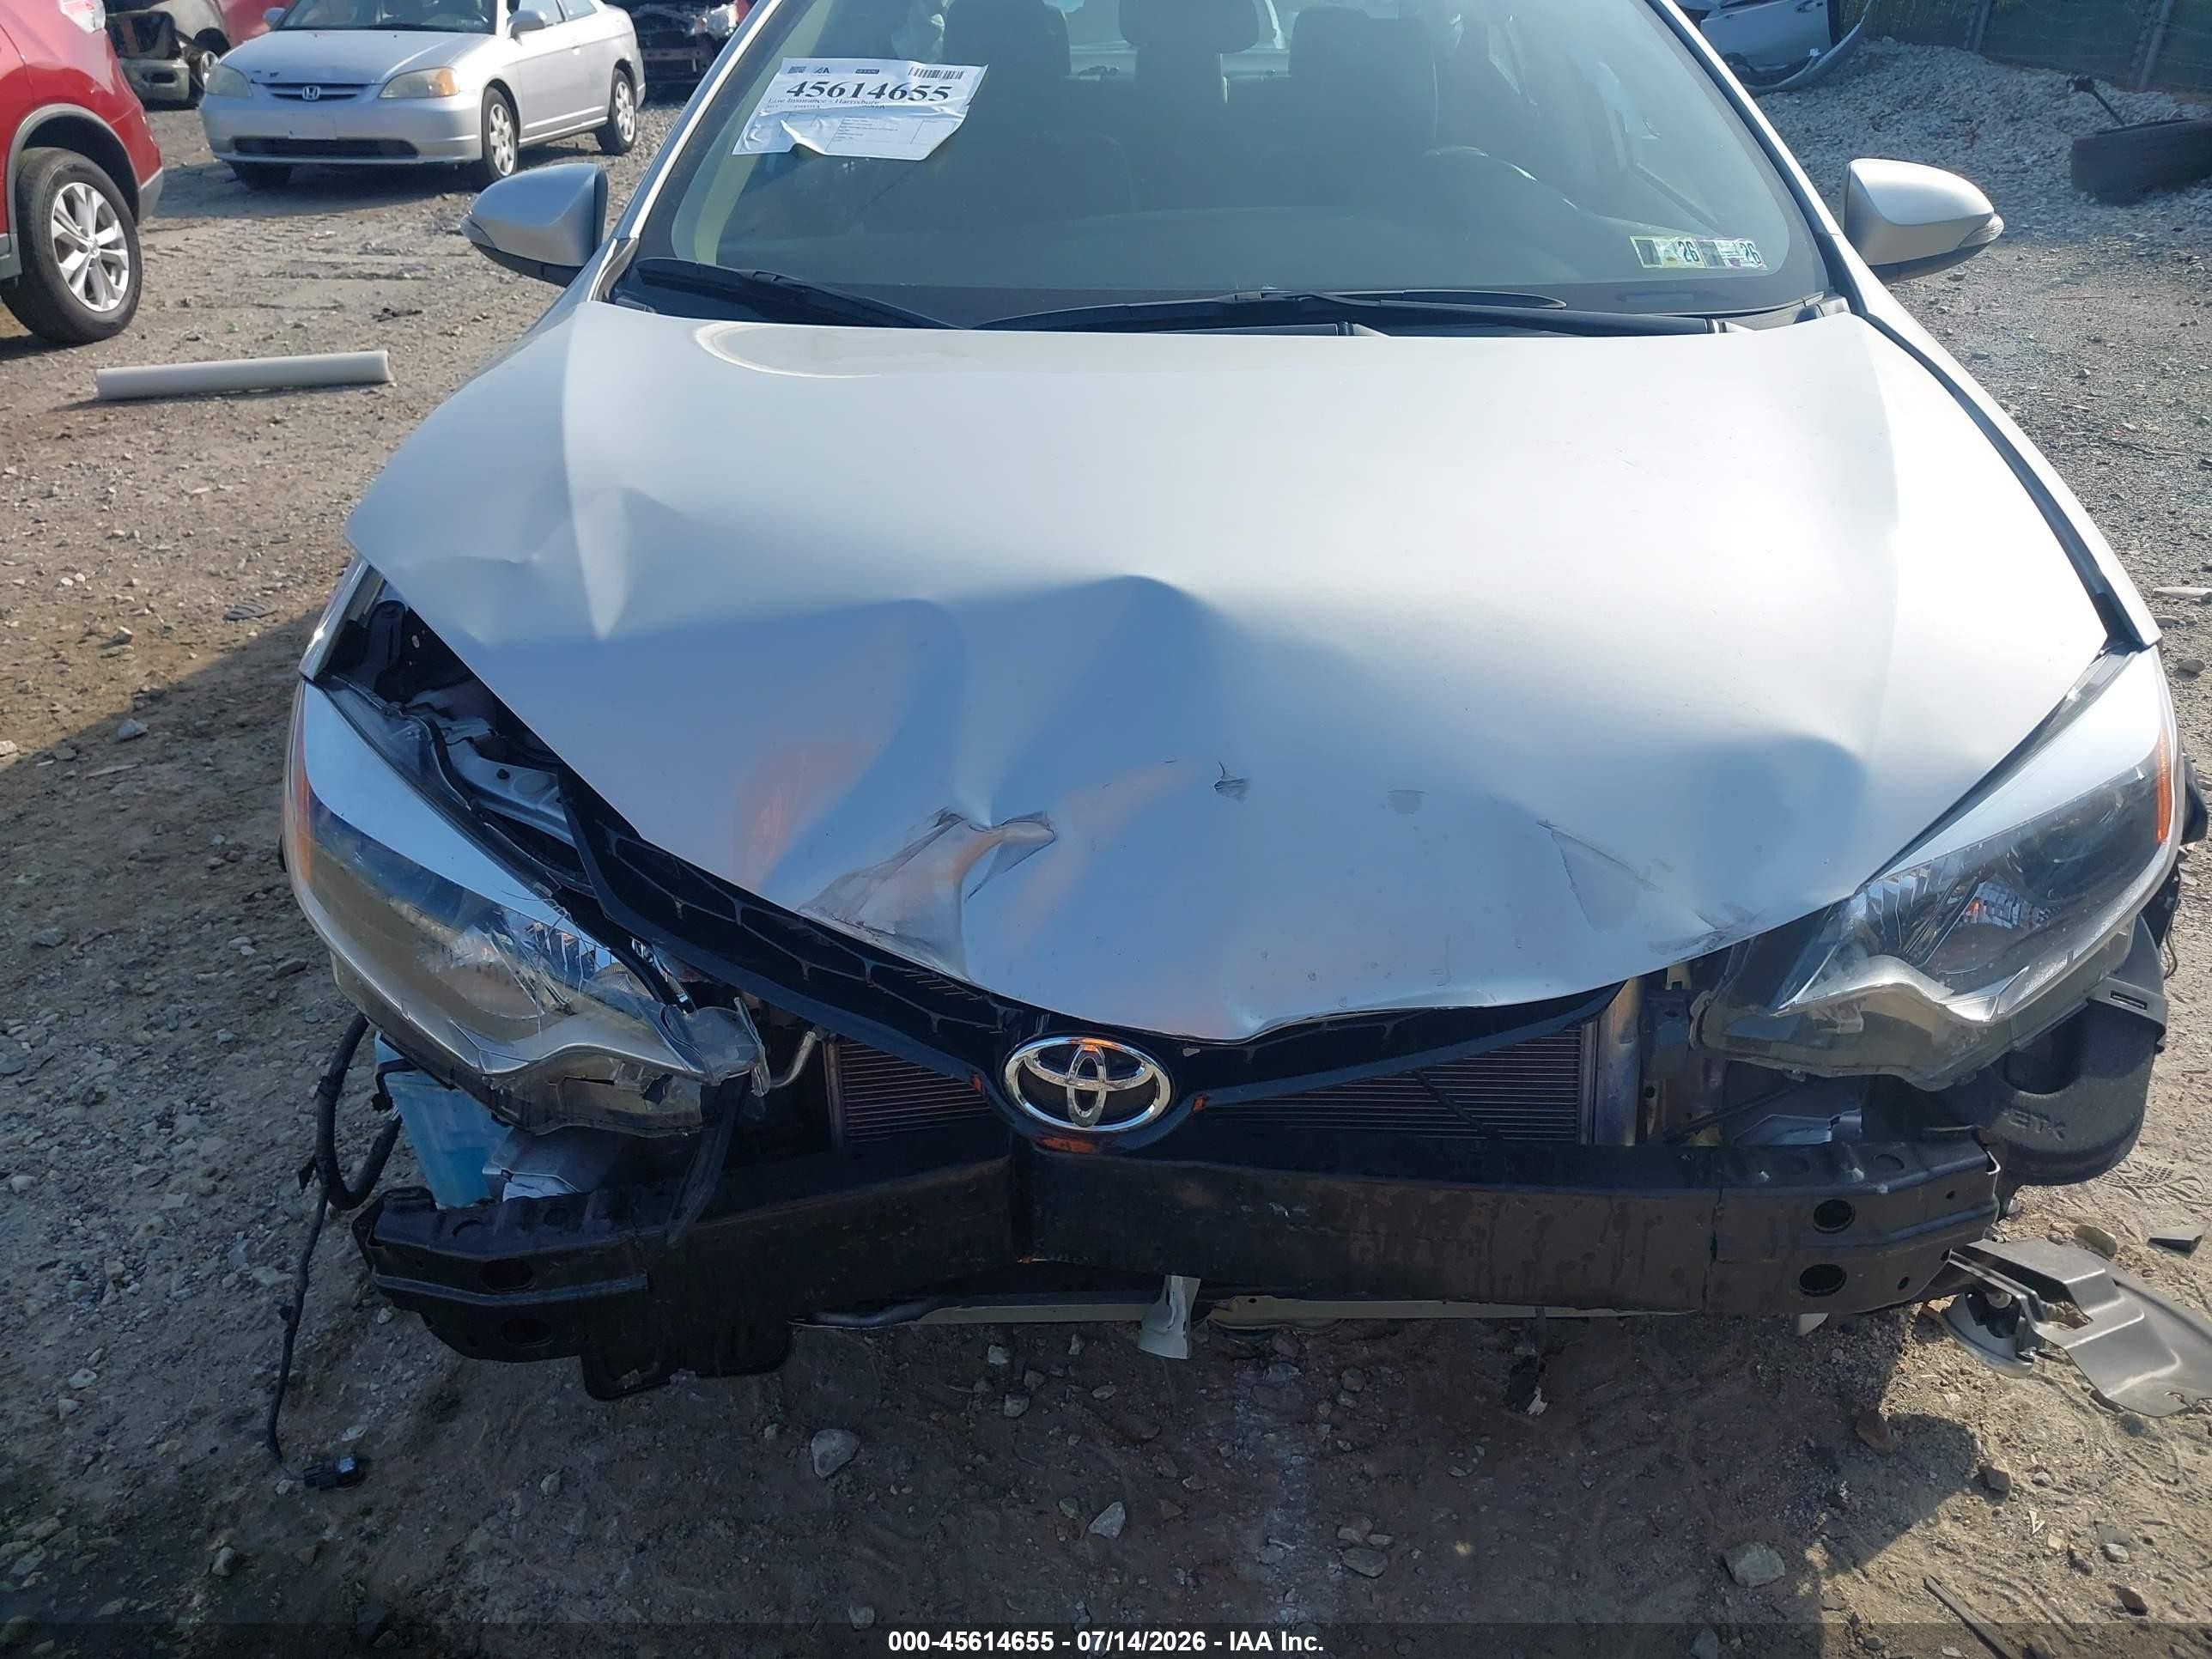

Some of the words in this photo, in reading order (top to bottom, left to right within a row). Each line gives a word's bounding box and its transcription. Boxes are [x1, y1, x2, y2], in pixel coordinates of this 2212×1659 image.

[787, 81, 953, 102] 45614655
[1678, 240, 1700, 263] 26
[1740, 242, 1762, 264] 26
